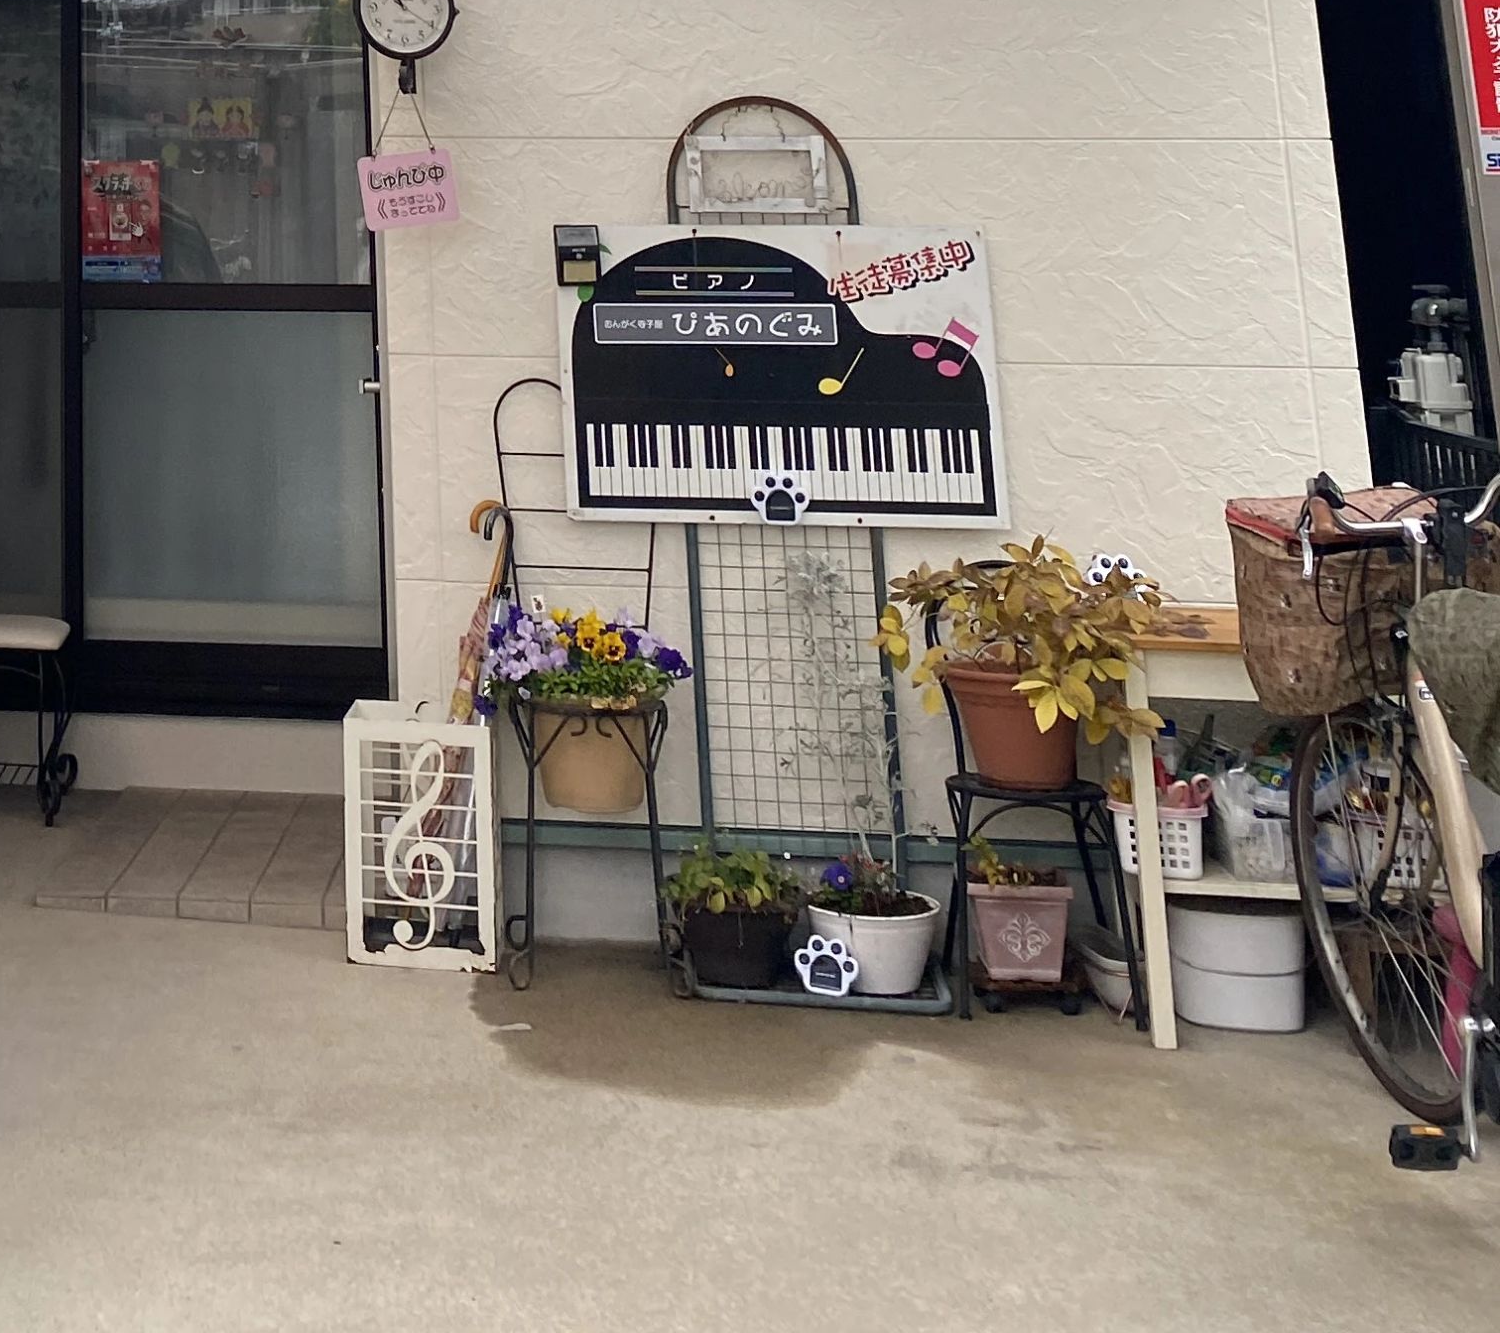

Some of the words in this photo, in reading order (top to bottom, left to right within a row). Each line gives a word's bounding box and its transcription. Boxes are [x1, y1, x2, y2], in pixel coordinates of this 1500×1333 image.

[672, 273, 755, 290] ピアノ
[828, 240, 974, 303] 生徒募集中
[671, 311, 823, 338] ぴあのぐみ
